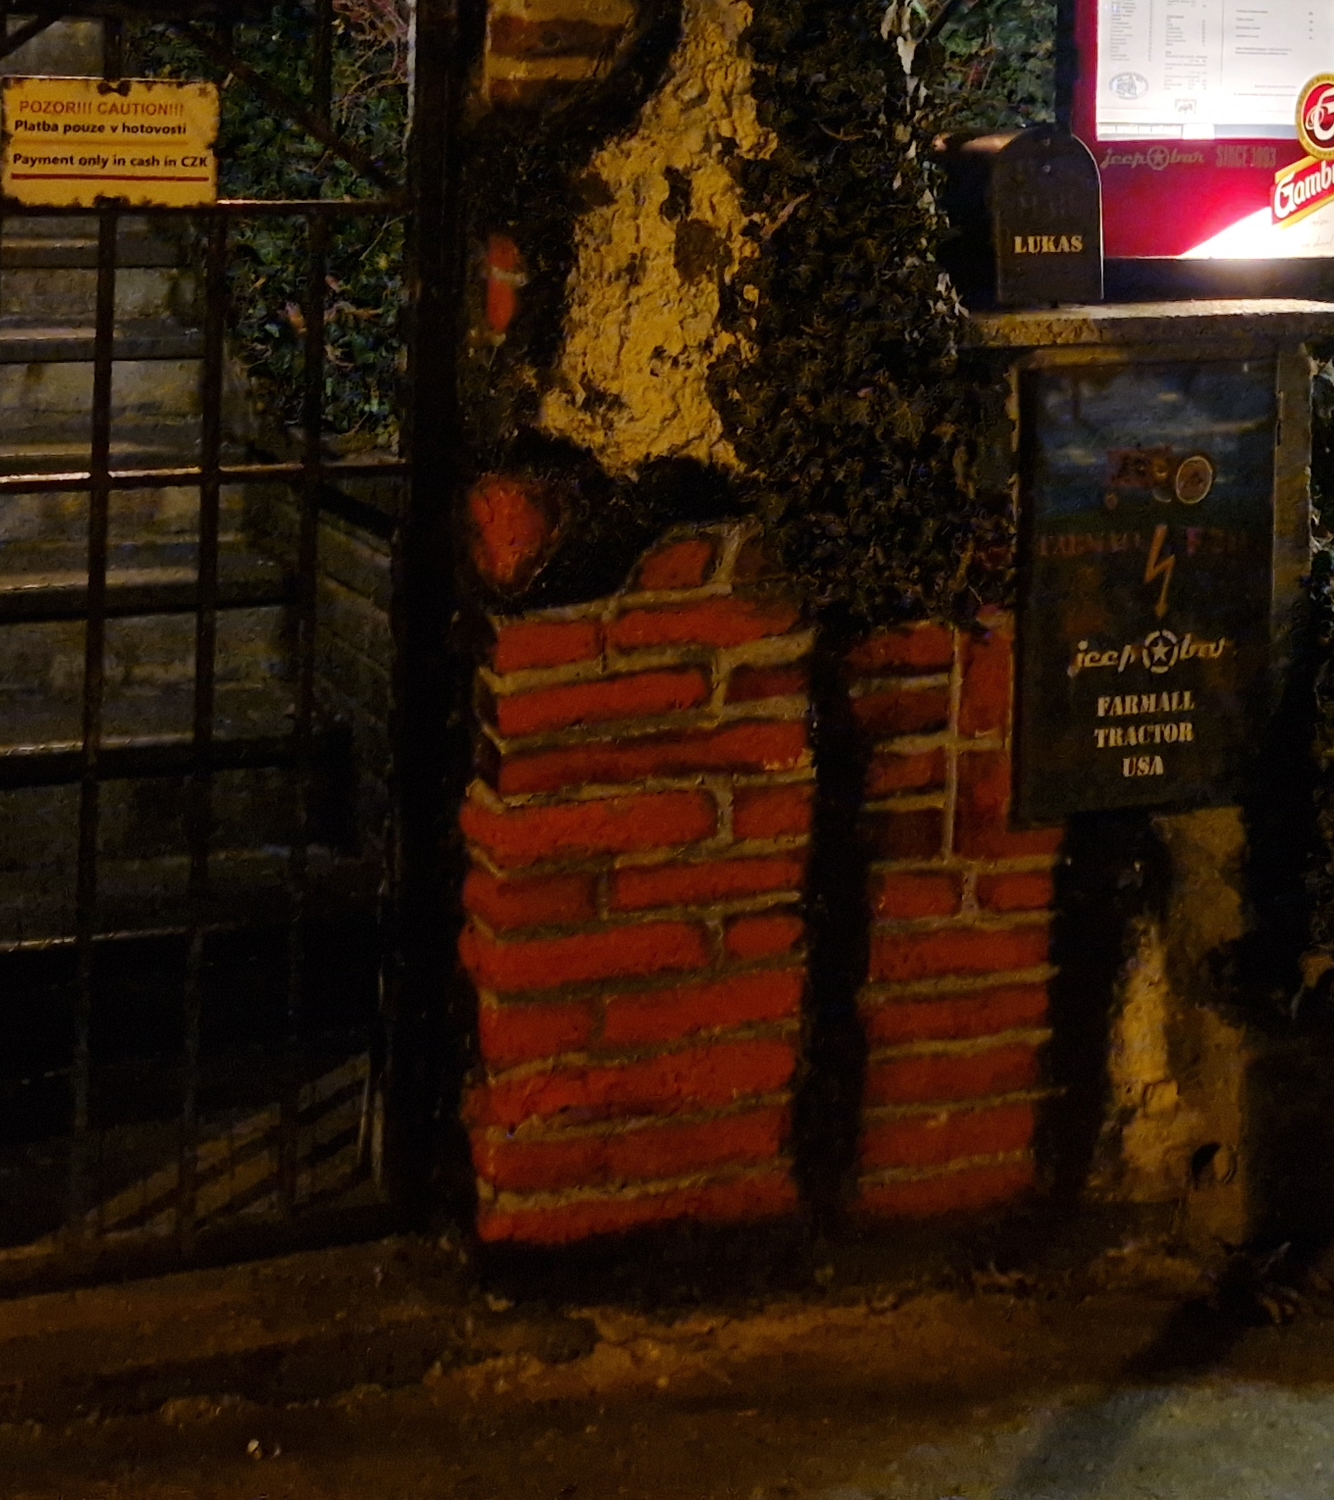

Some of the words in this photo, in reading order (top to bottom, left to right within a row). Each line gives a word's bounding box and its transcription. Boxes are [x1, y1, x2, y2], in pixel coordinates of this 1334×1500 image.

[19, 100, 93, 116] POZOR!!!
[97, 102, 185, 118] CAUTION!!!
[14, 119, 59, 133] Platba
[63, 123, 106, 136] pouze
[111, 125, 118, 134] v
[122, 122, 187, 136] hotovosti
[13, 152, 75, 168] Payment
[78, 154, 109, 169] only
[113, 154, 126, 167] in
[130, 155, 160, 167] cash
[164, 155, 177, 167] in
[181, 156, 208, 168] CZK
[1099, 148, 1148, 169] jeep
[1169, 148, 1205, 164] bar
[1014, 235, 1084, 254] LUKAS
[1068, 639, 1136, 678] jeep
[1097, 689, 1196, 718] FARMALL
[1093, 721, 1195, 749] TRACTOR
[1122, 754, 1165, 778] USA
